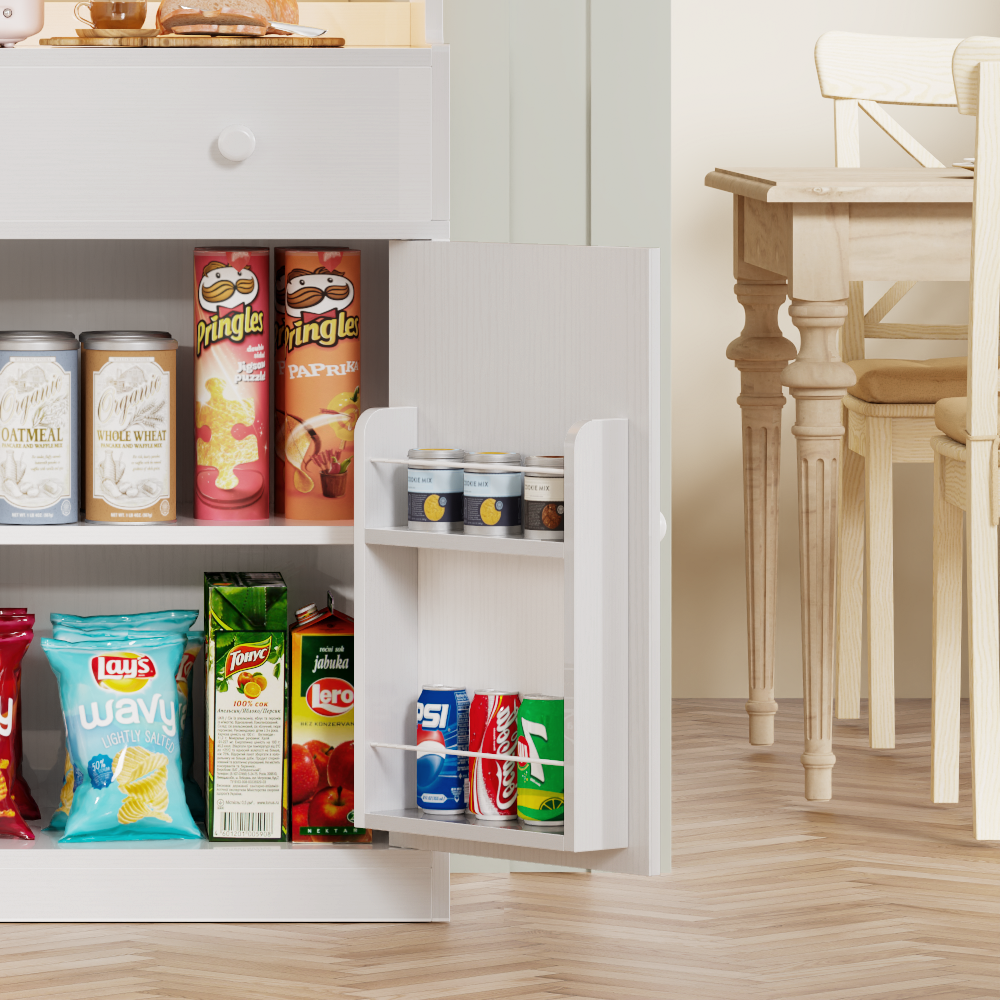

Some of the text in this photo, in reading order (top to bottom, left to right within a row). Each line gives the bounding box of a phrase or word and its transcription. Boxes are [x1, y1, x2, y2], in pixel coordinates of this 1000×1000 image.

[197, 305, 264, 357] Pringles
[288, 361, 359, 379] PAPRIKA
[0, 374, 62, 426] Organic
[97, 374, 162, 426] Organic
[1, 427, 64, 442] OATMEAL
[97, 429, 167, 442] WHOLE WHEAT
[97, 656, 150, 680] Lay's
[312, 654, 350, 673] jabuka
[312, 683, 354, 709] Lero
[78, 693, 177, 737] wavy
[101, 729, 175, 753] LIGHTLY SALTED
[91, 758, 107, 772] 50%
